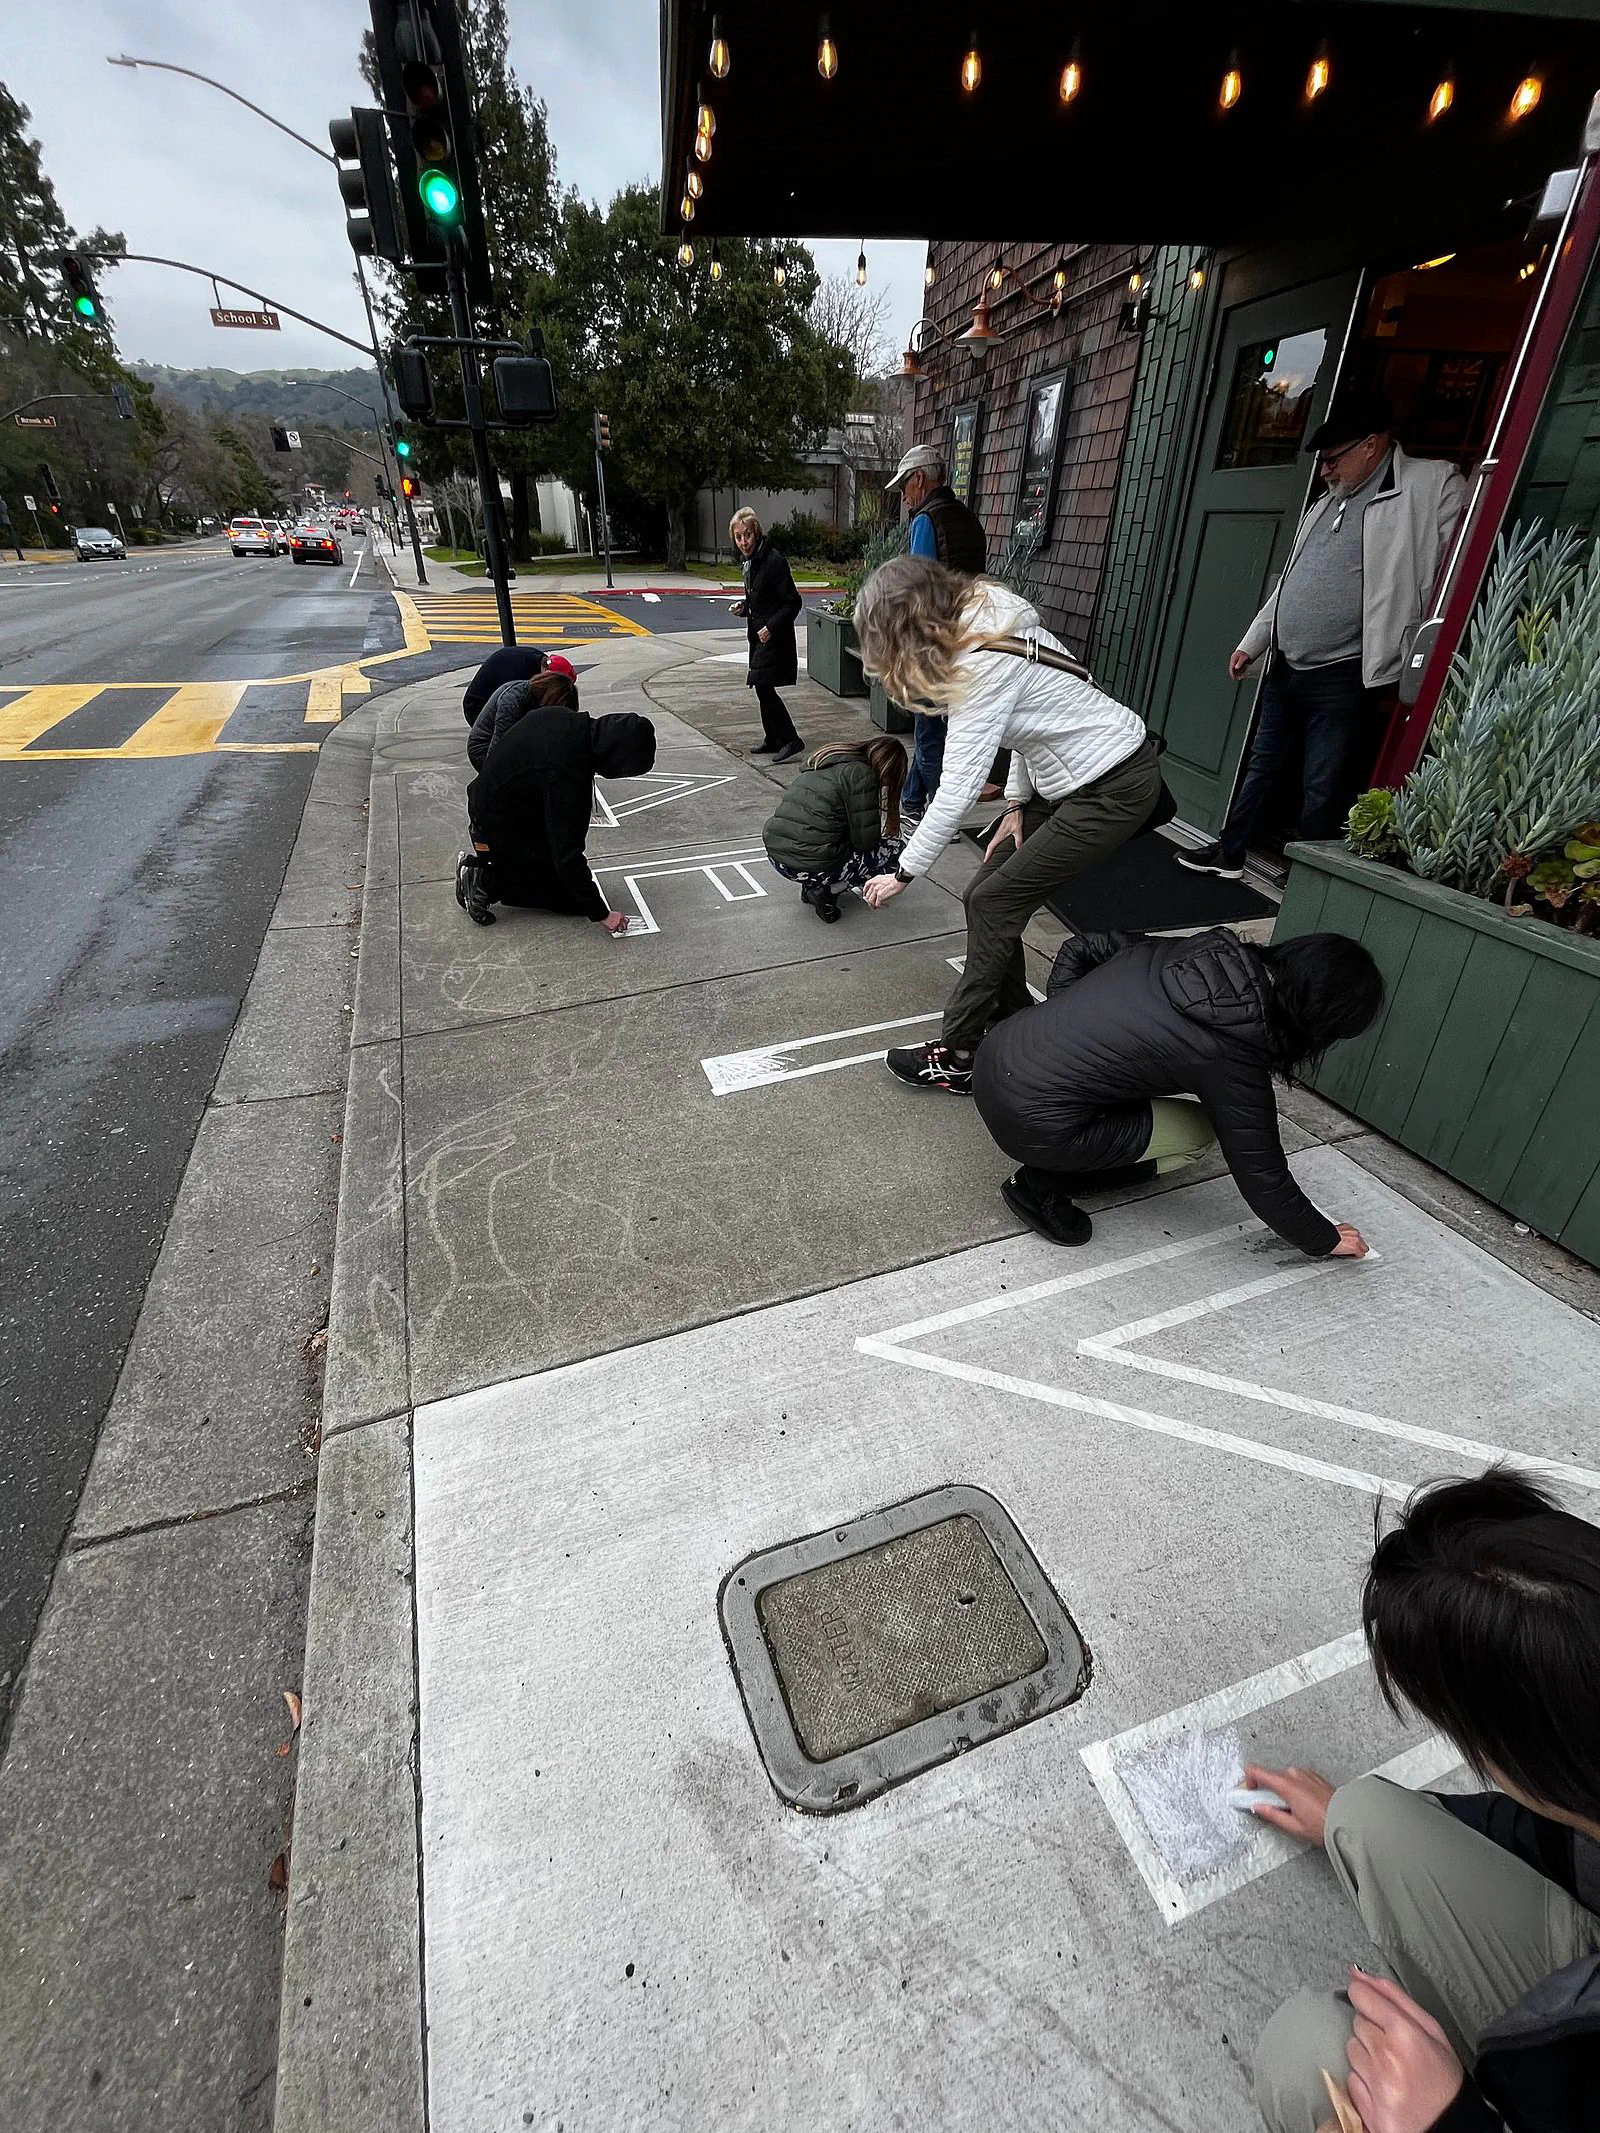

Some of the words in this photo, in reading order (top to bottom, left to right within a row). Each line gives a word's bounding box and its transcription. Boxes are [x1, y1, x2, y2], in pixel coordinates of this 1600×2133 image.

[217, 311, 257, 324] School
[262, 314, 274, 326] St
[820, 1605, 868, 1693] WATER
